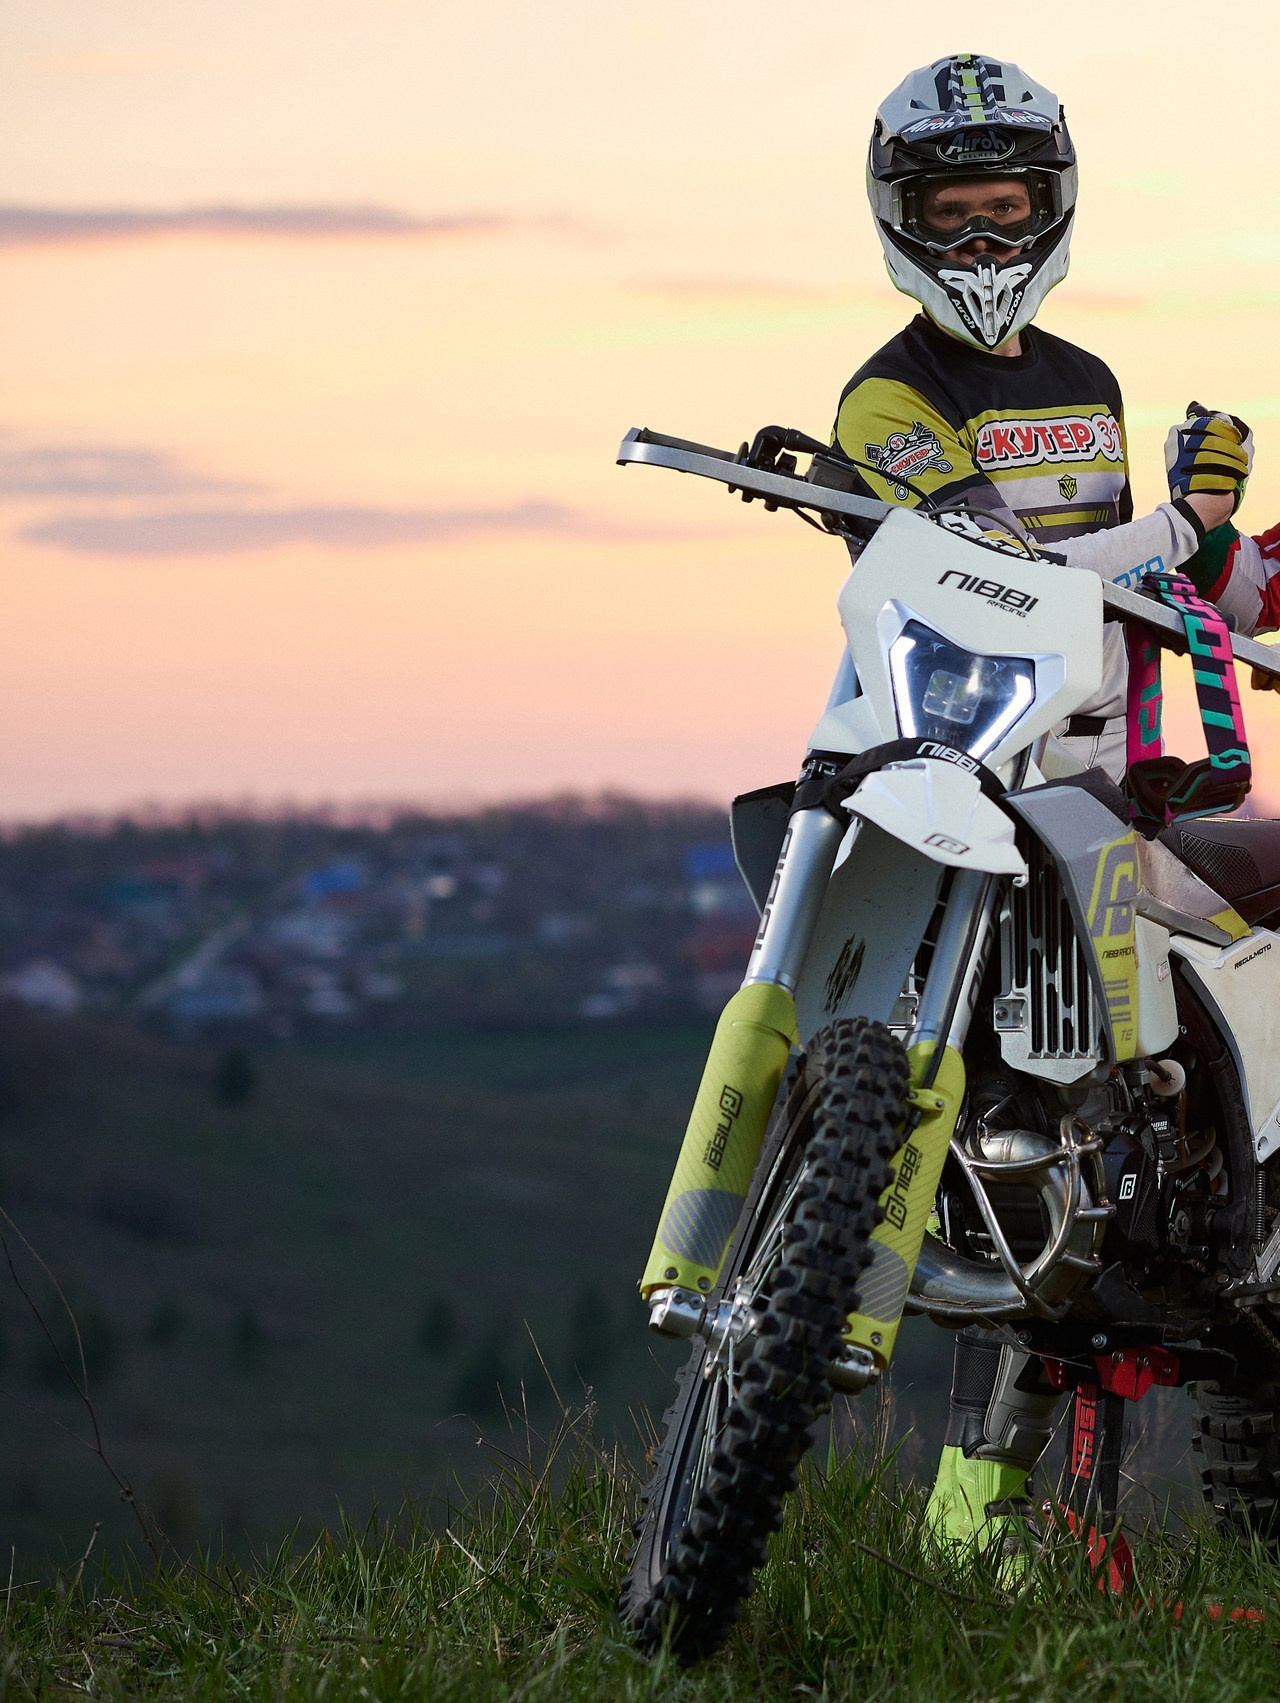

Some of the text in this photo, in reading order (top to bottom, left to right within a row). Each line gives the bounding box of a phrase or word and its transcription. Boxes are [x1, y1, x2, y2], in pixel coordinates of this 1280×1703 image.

[901, 115, 955, 134] Airoh
[1000, 110, 1050, 124] Airoh
[944, 129, 1008, 156] Airoh
[961, 152, 994, 160] HELMET
[951, 298, 976, 330] Airoh
[1005, 290, 1024, 327] Airoh
[976, 422, 1092, 458] СКУТЕР
[890, 448, 929, 473] СКУТЕР
[937, 570, 1039, 612] NIBBI
[986, 599, 1028, 618] RACING
[916, 741, 981, 776] NIBBI
[1234, 943, 1272, 970] REGULMOTO
[894, 1142, 919, 1202] NIBBI
